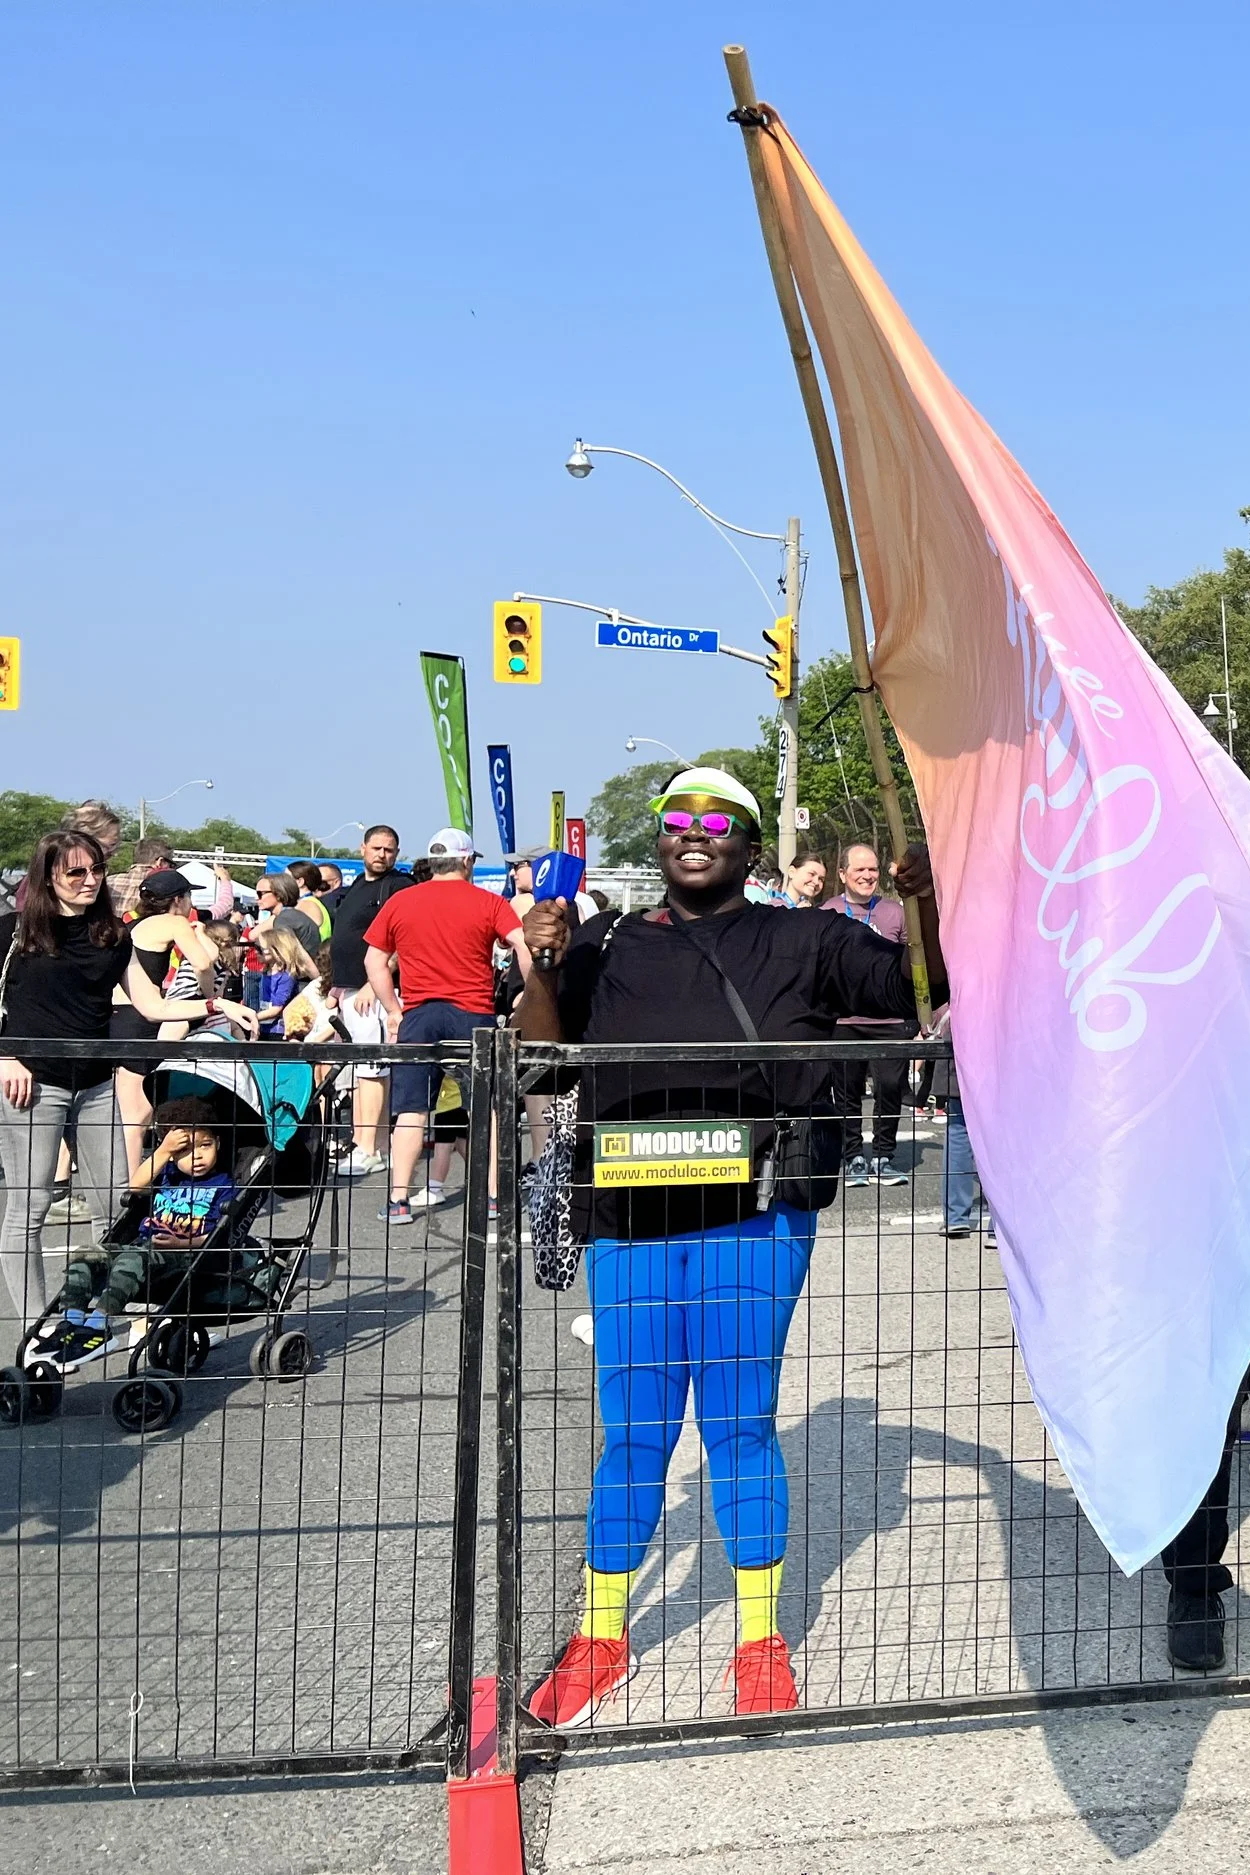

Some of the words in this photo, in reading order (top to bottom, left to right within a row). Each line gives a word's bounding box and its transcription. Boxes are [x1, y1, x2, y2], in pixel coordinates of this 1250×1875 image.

[617, 628, 683, 648] Ontario
[689, 632, 700, 642] Dr
[777, 730, 787, 796] 274
[535, 859, 551, 887] e
[602, 1164, 741, 1181] www.moduloc.com
